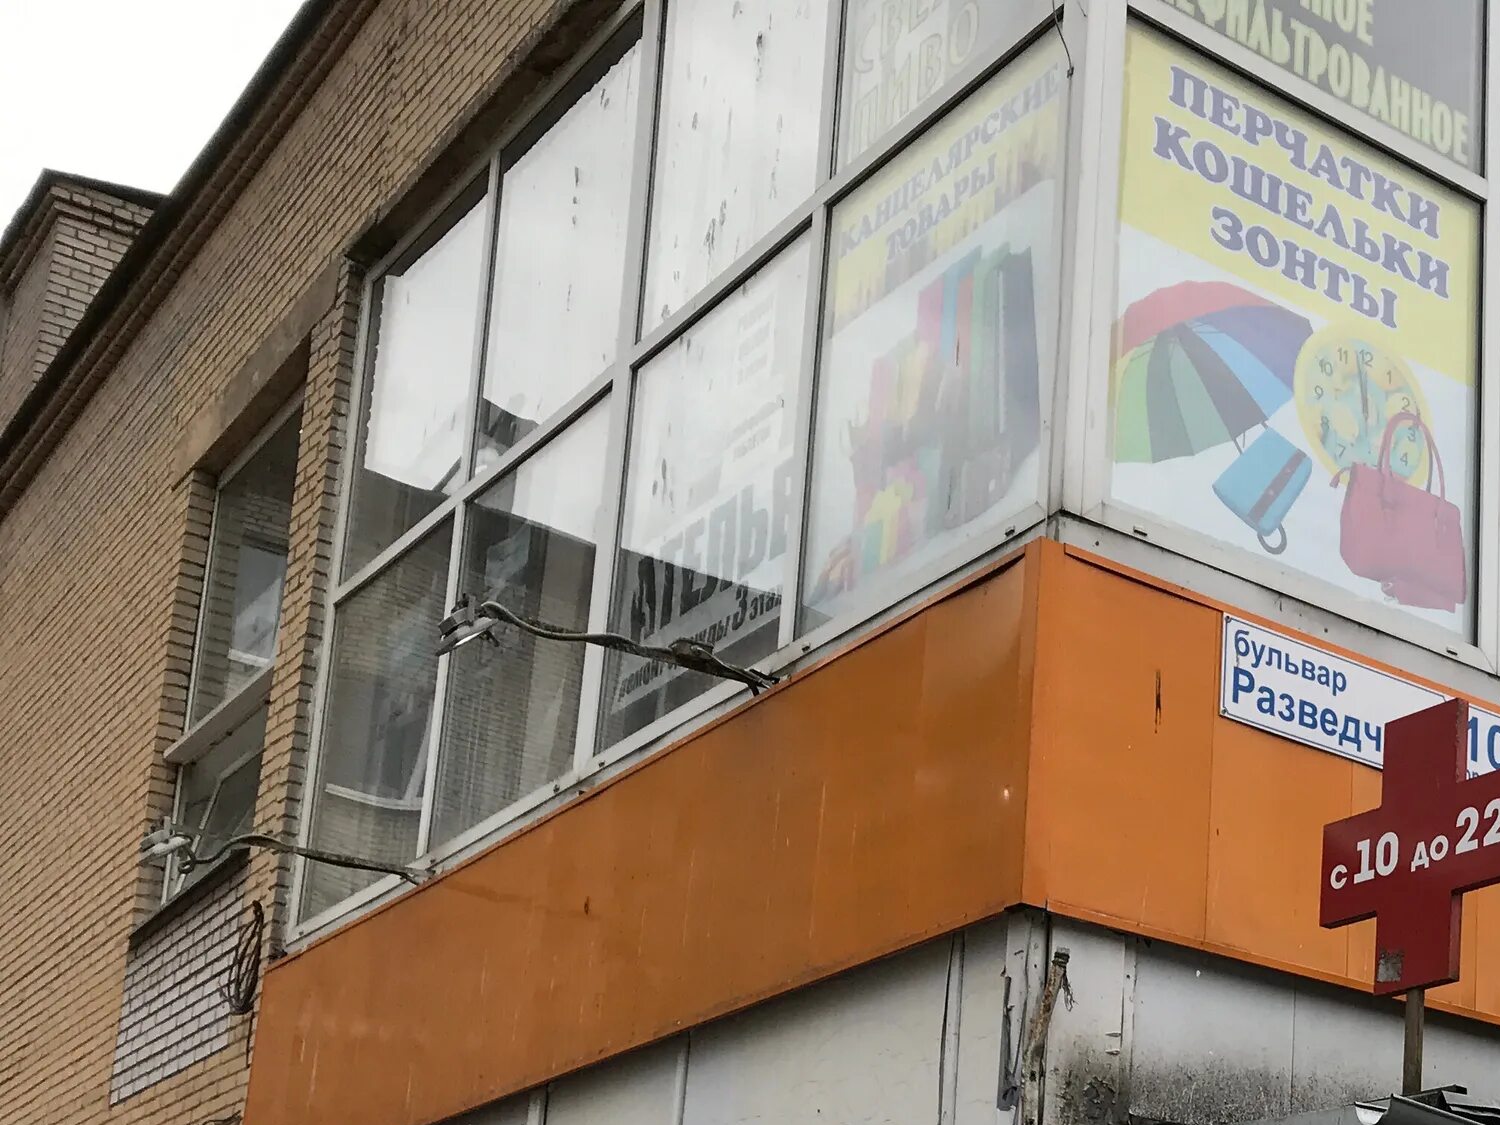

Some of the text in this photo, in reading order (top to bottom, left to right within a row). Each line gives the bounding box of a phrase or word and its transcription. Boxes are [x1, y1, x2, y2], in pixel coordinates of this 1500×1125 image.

[841, 62, 1060, 258] КАНЦЕЛЯРСКИЕ
[887, 153, 998, 263] ТОВАРЫ
[1152, 115, 1450, 299] КОШЕЛЬКИ
[1168, 66, 1441, 240] ПЕРЧАТКИ
[1210, 205, 1398, 329] ЗОНТЫ
[1359, 349, 1374, 368] 12
[1232, 666, 1382, 752] Разведч
[1234, 629, 1347, 696] бульвар
[1353, 831, 1399, 884] 10
